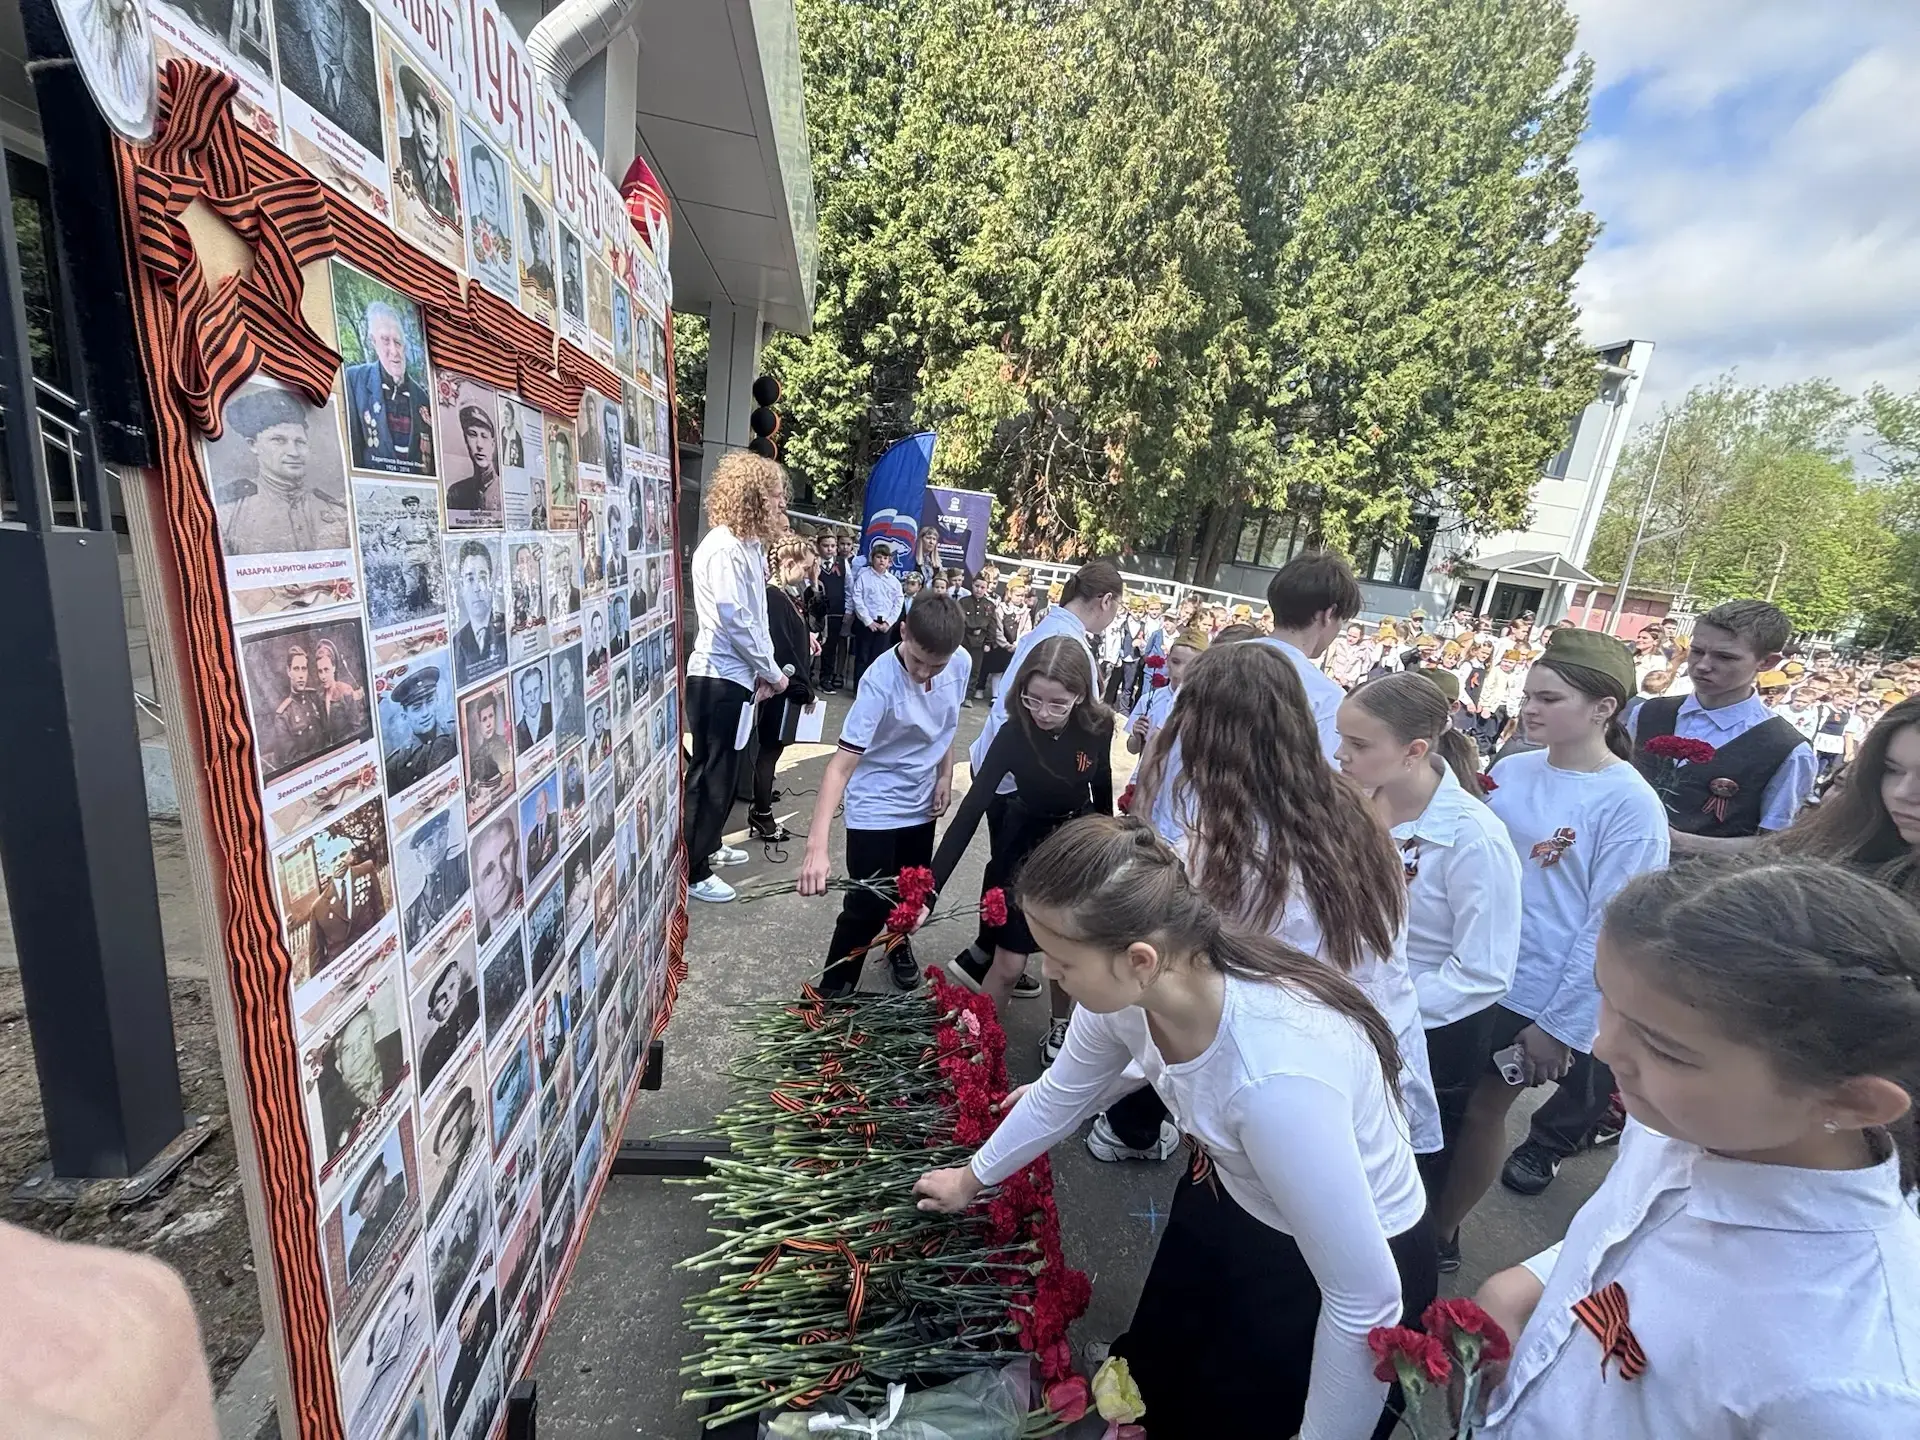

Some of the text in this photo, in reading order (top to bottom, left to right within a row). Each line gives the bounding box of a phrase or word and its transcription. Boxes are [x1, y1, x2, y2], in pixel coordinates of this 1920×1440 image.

[179, 29, 222, 67] Василий
[236, 566, 271, 577] НАЗАРУК
[273, 563, 307, 574] ХАРИТОН
[394, 625, 413, 637] Андрей
[277, 751, 369, 801] Земскова Любовь Павловна
[320, 948, 357, 983] Нестеренко
